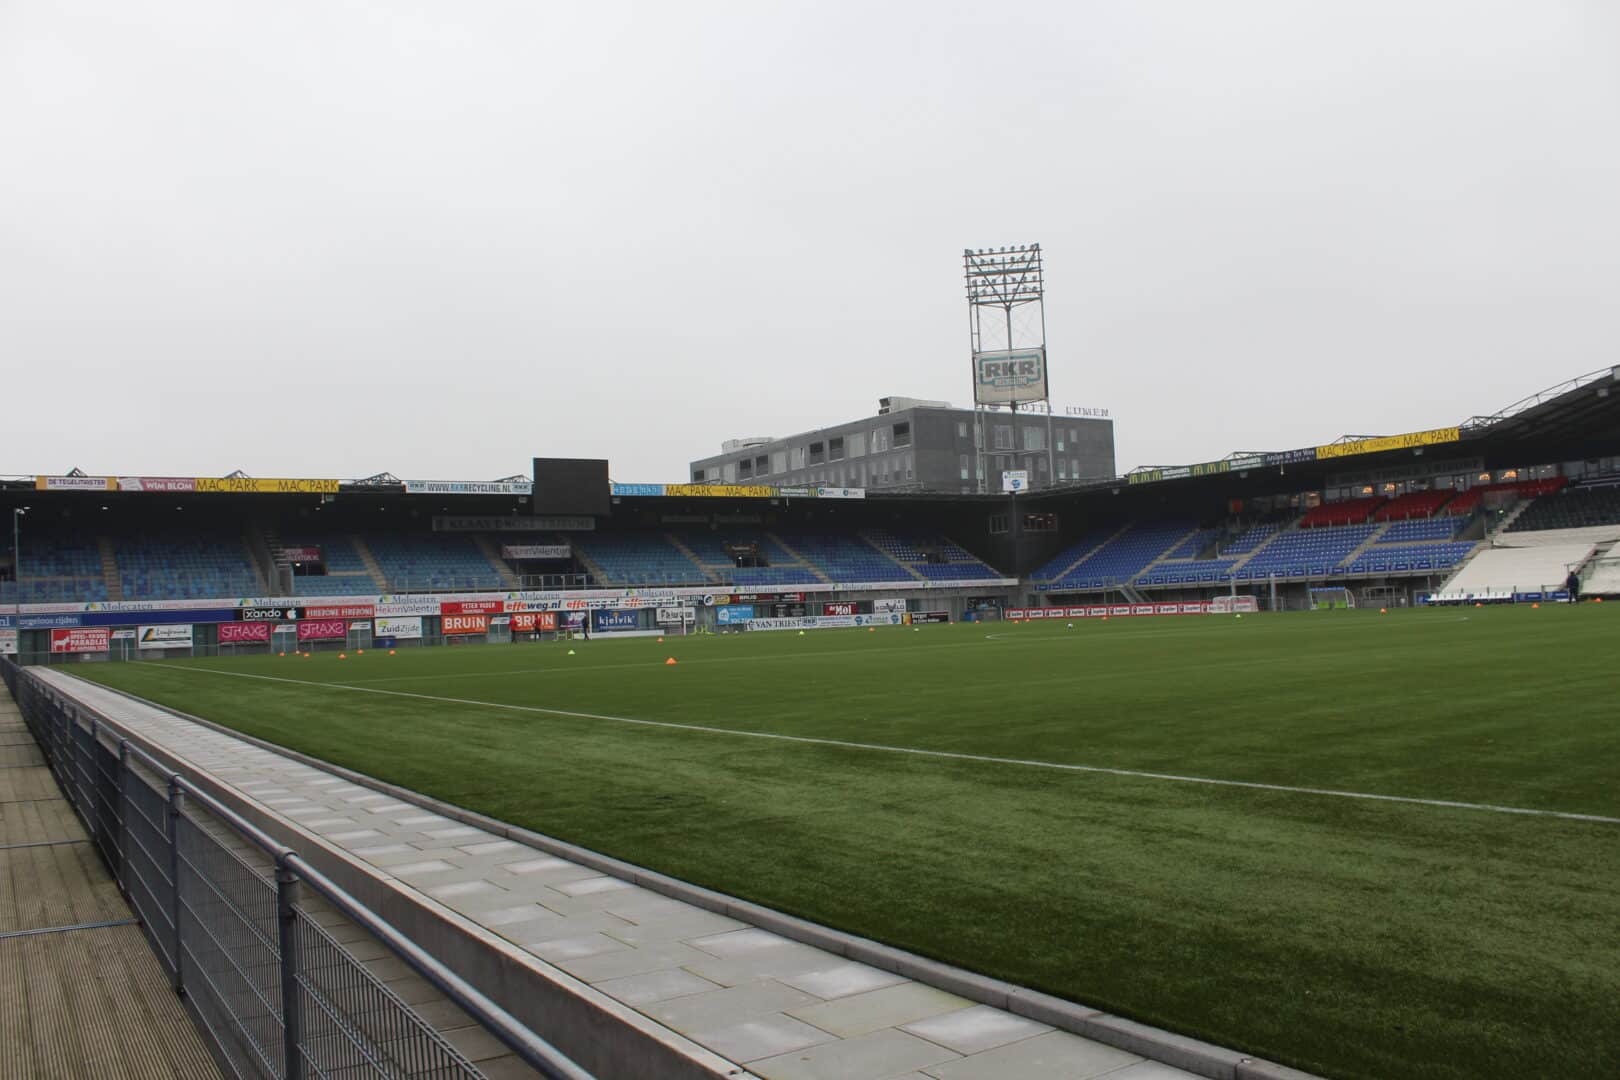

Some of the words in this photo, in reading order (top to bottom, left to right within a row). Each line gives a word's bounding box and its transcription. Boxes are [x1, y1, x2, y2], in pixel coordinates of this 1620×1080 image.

[984, 360, 1034, 377] RKR
[1066, 406, 1109, 417] LUMEN
[168, 481, 193, 490] BLOM
[101, 602, 153, 611] Molecaten
[506, 600, 562, 611] effeweg.nl
[835, 604, 853, 615] Mol
[246, 609, 281, 619] xando
[55, 615, 79, 626] rijden
[756, 620, 772, 629] VAN
[775, 619, 801, 628] TRIEST
